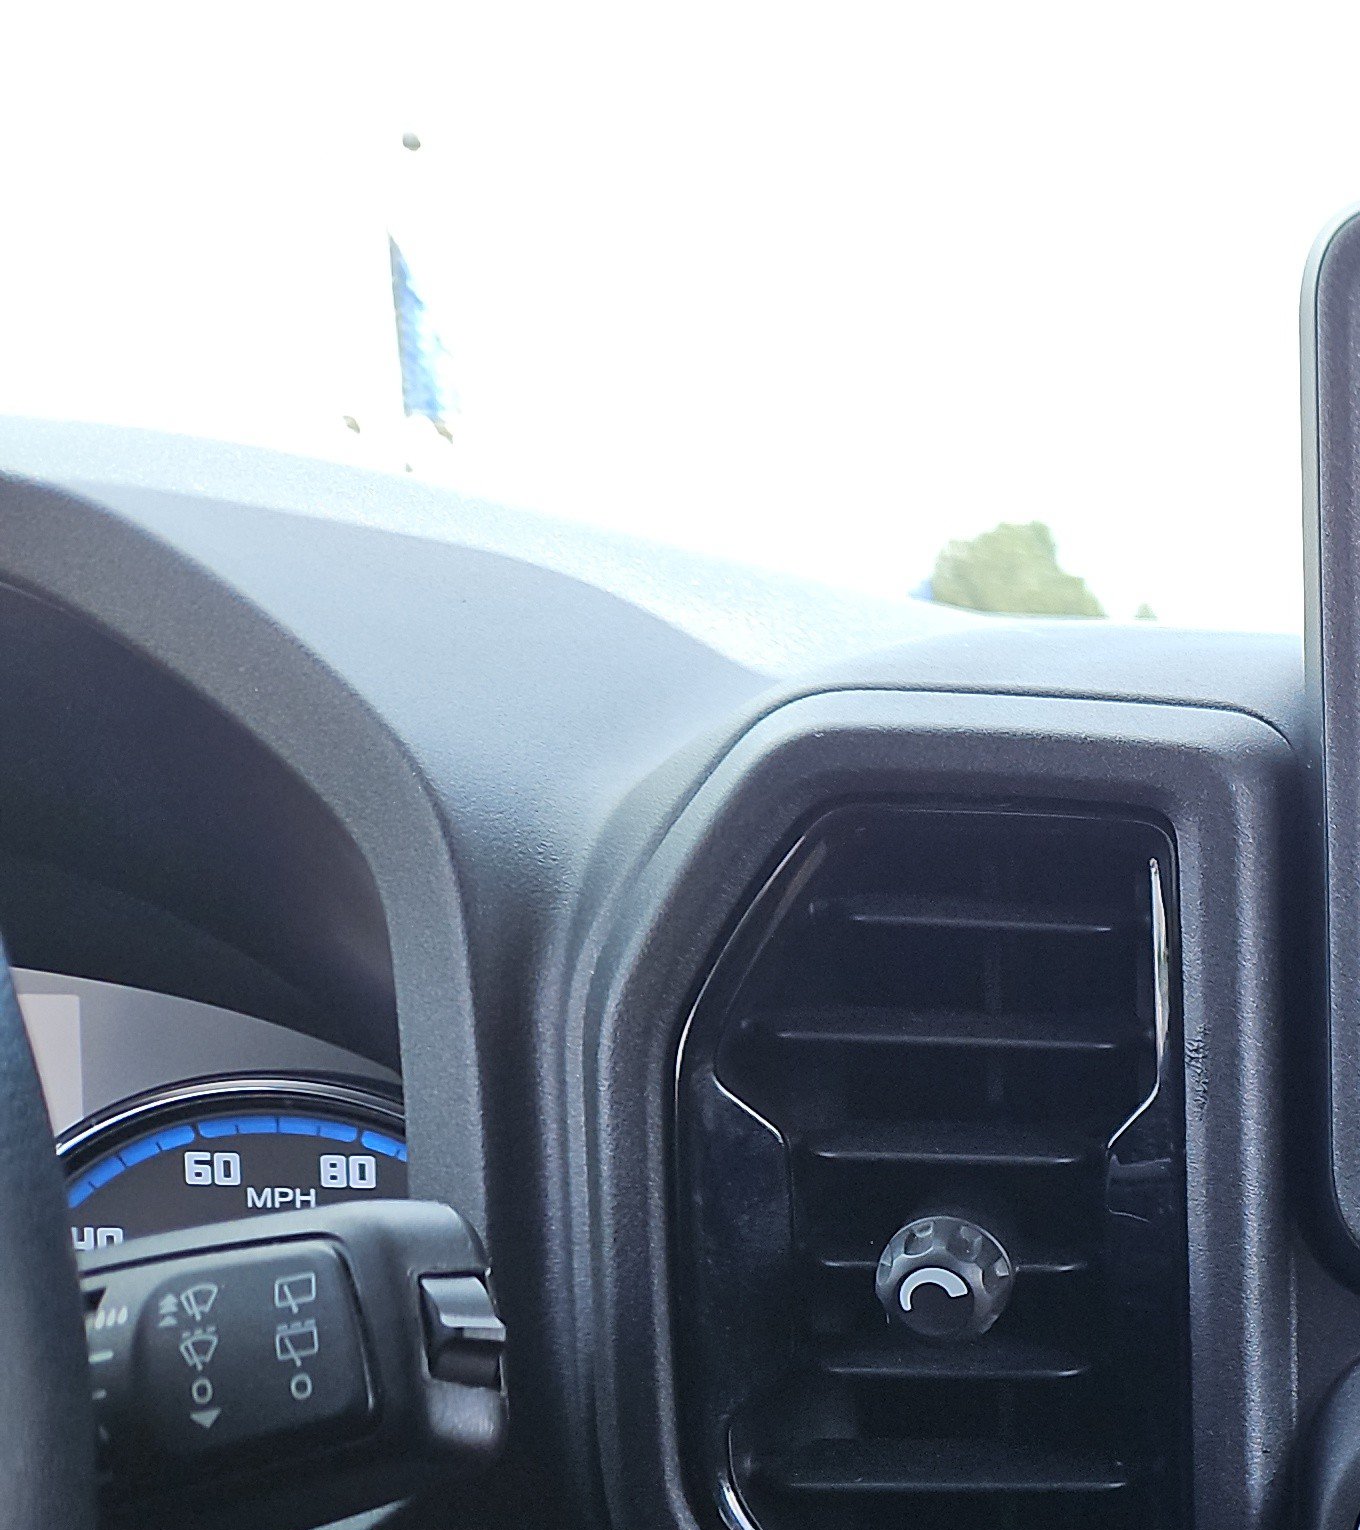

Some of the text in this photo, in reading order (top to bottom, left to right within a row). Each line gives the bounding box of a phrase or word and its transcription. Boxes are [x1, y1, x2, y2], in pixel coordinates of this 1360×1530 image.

[184, 1151, 241, 1186] 60
[319, 1154, 377, 1189] 80
[246, 1187, 317, 1209] MPH
